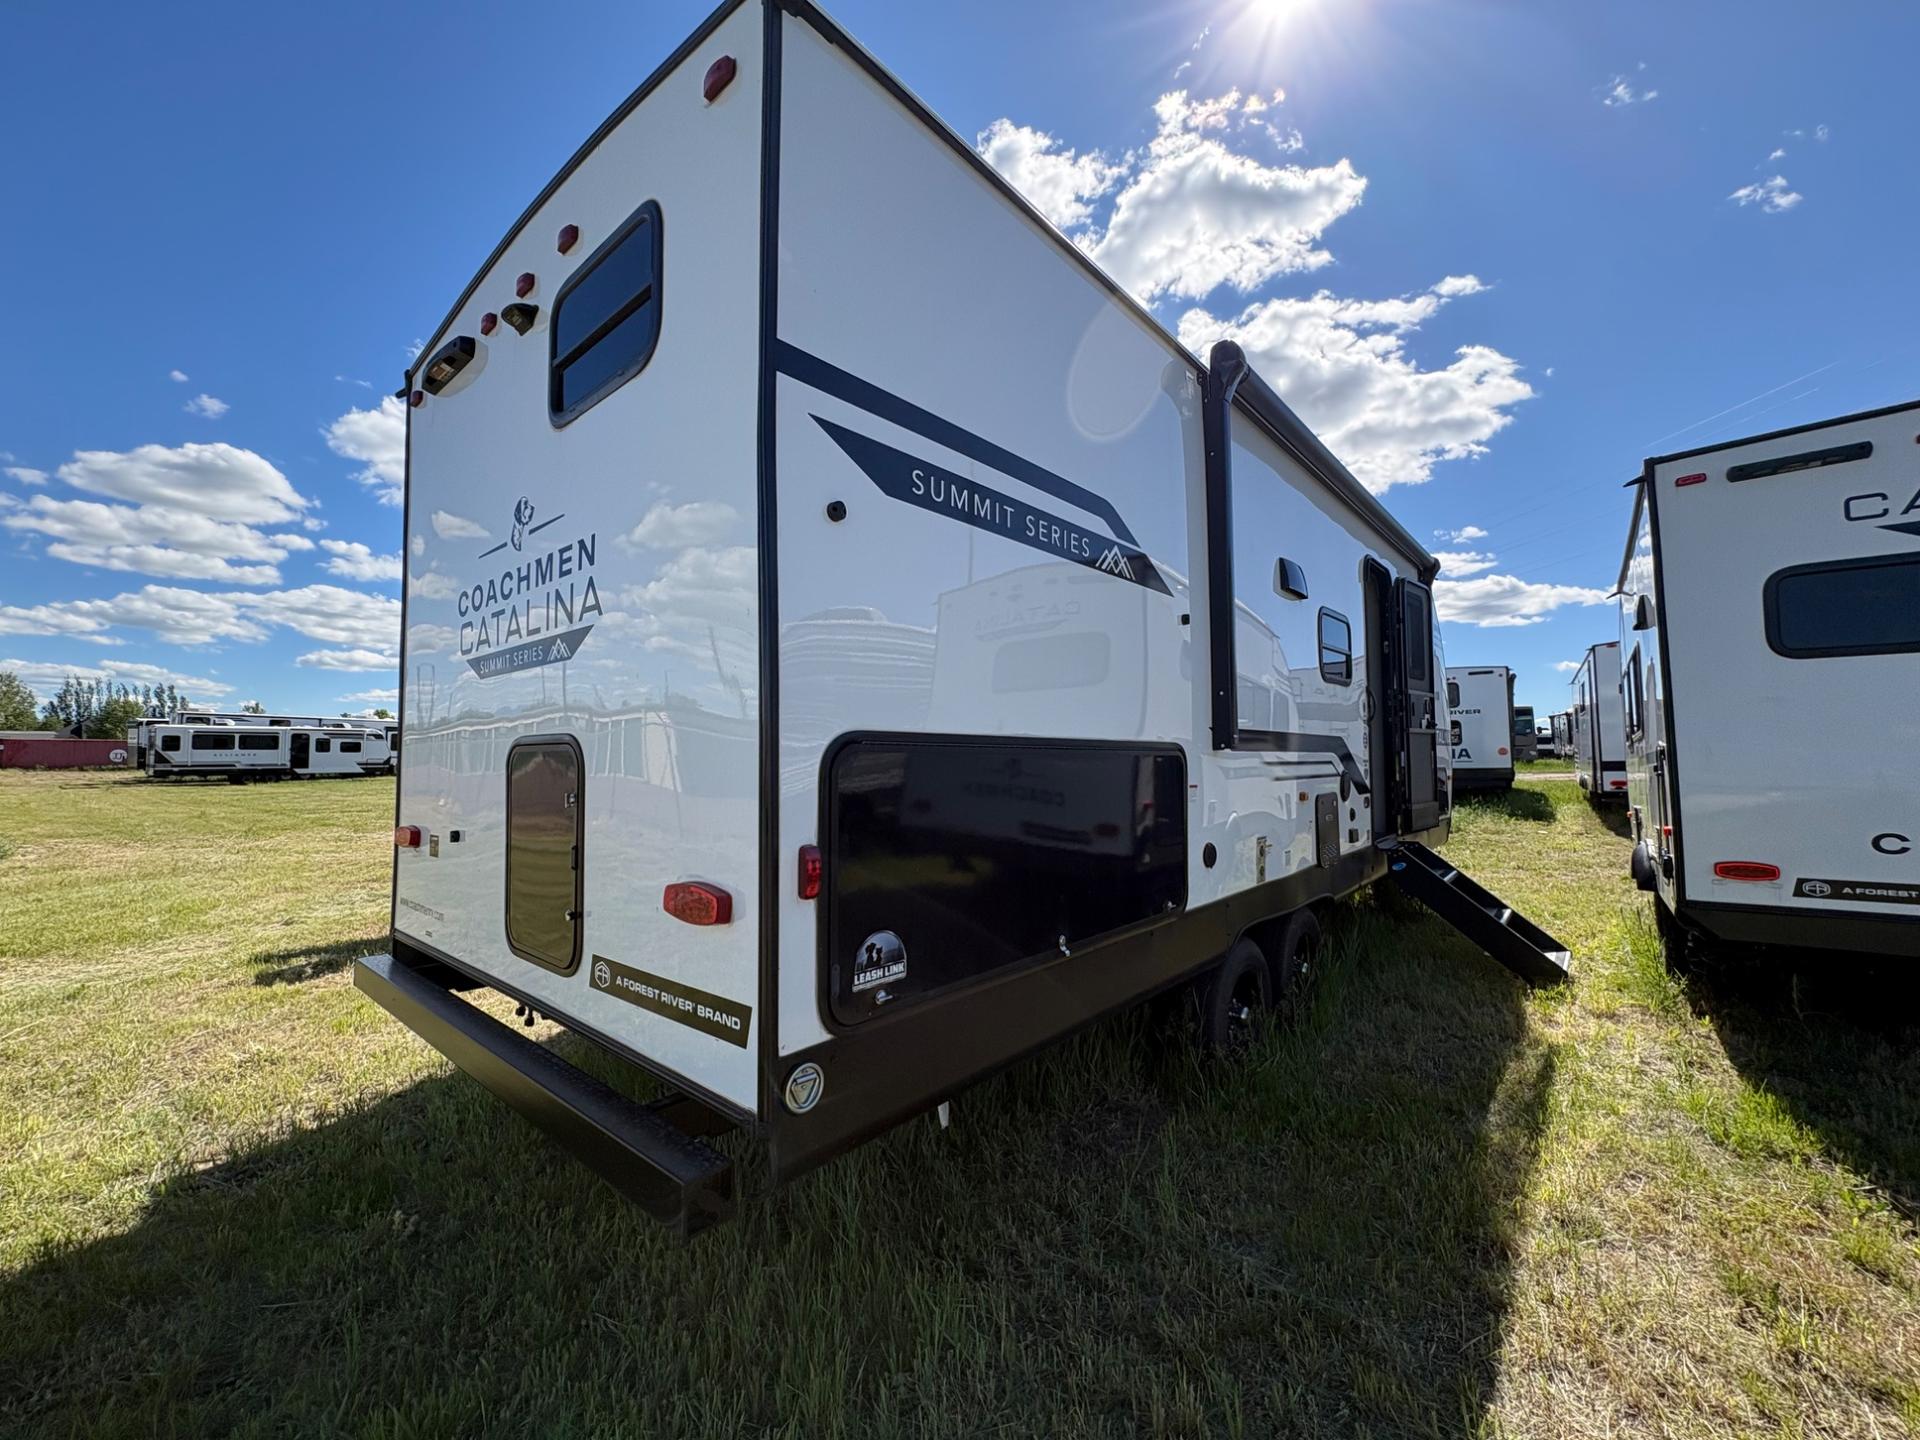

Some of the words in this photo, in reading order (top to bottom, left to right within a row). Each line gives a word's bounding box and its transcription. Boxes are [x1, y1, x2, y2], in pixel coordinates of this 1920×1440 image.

[911, 469, 1015, 529] SUMMIT
[1025, 514, 1091, 557] SERIES
[458, 532, 596, 617] COACHMEN
[460, 575, 604, 656] CATALINA
[480, 653, 511, 674] SUMMIT
[513, 645, 544, 666] SERIES
[1855, 888, 1919, 898] FOREST
[854, 967, 884, 985] LEASH
[884, 962, 905, 977] LINK
[615, 975, 623, 987] A
[623, 978, 660, 1000] FOREST
[697, 1004, 741, 1031] BRAND
